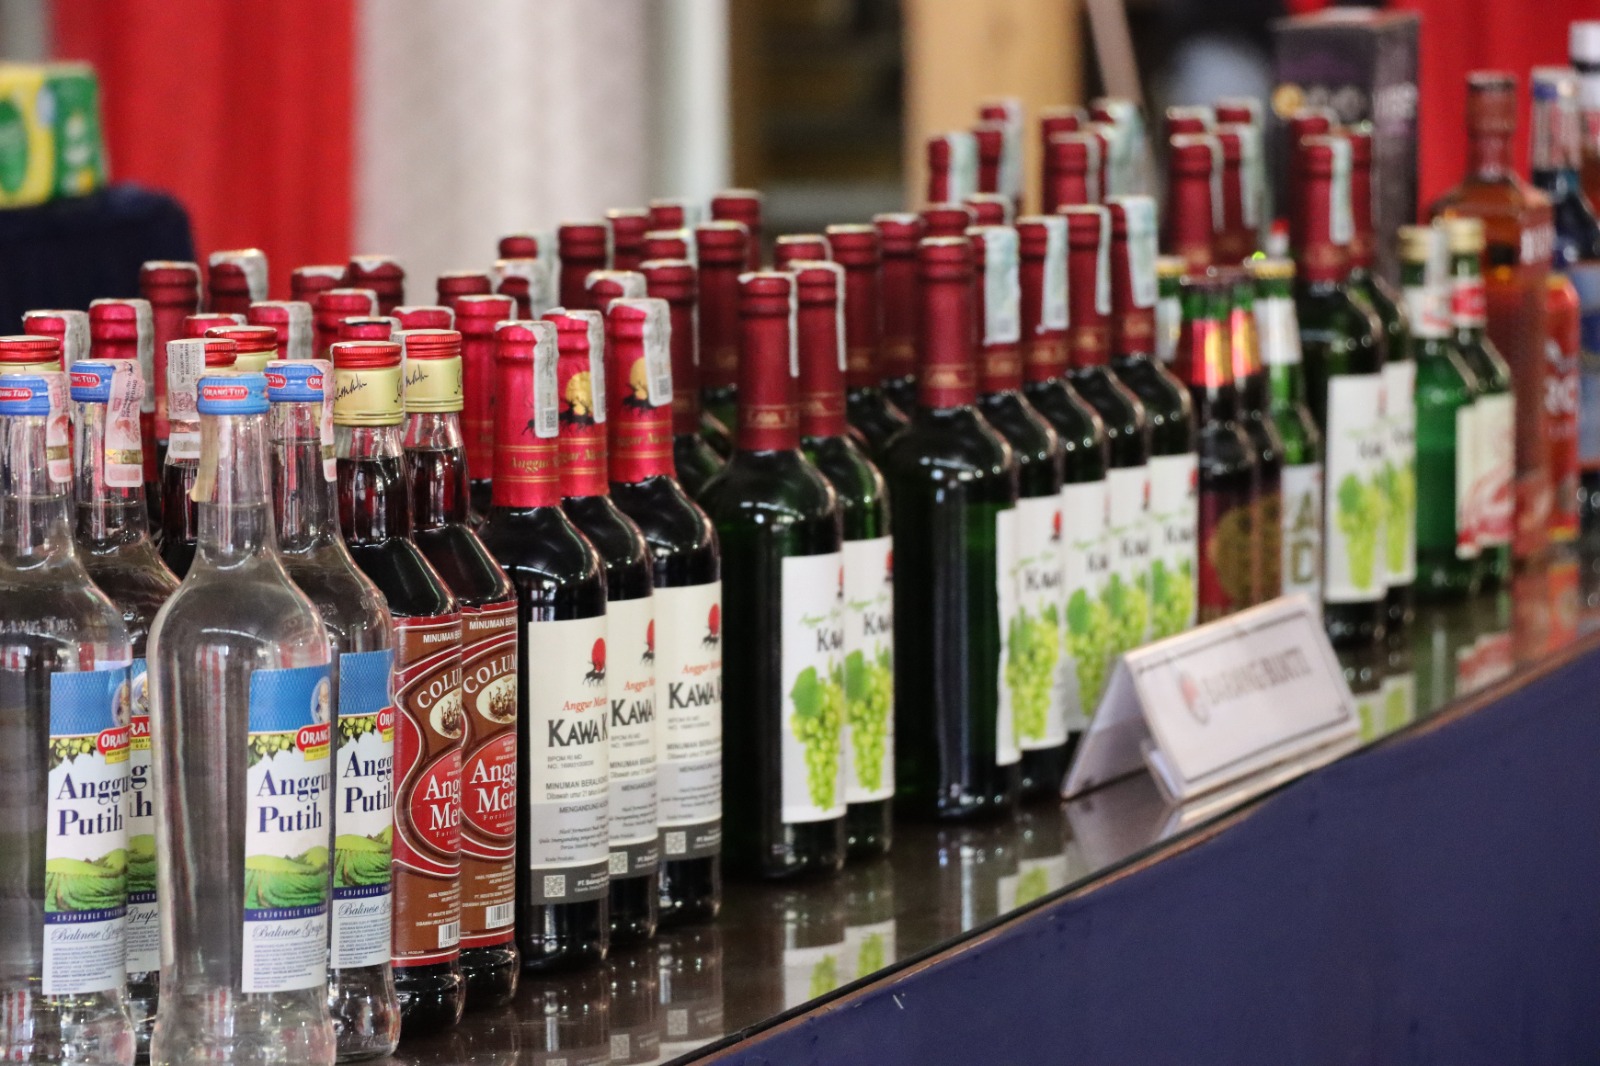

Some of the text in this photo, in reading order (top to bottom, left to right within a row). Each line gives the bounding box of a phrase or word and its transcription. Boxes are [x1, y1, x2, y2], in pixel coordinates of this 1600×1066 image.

[203, 387, 245, 396] ORANG TUA
[469, 619, 504, 630] MINUMAN
[423, 632, 455, 644] MINUMAN
[562, 700, 593, 713] Anggur
[548, 718, 601, 748] KAWA
[545, 781, 580, 791] MINUMAN
[56, 805, 123, 836] Putih
[257, 802, 322, 833] Putih
[338, 901, 379, 916] Balinese
[51, 927, 100, 941] Balinese
[253, 923, 300, 939] Balinese
